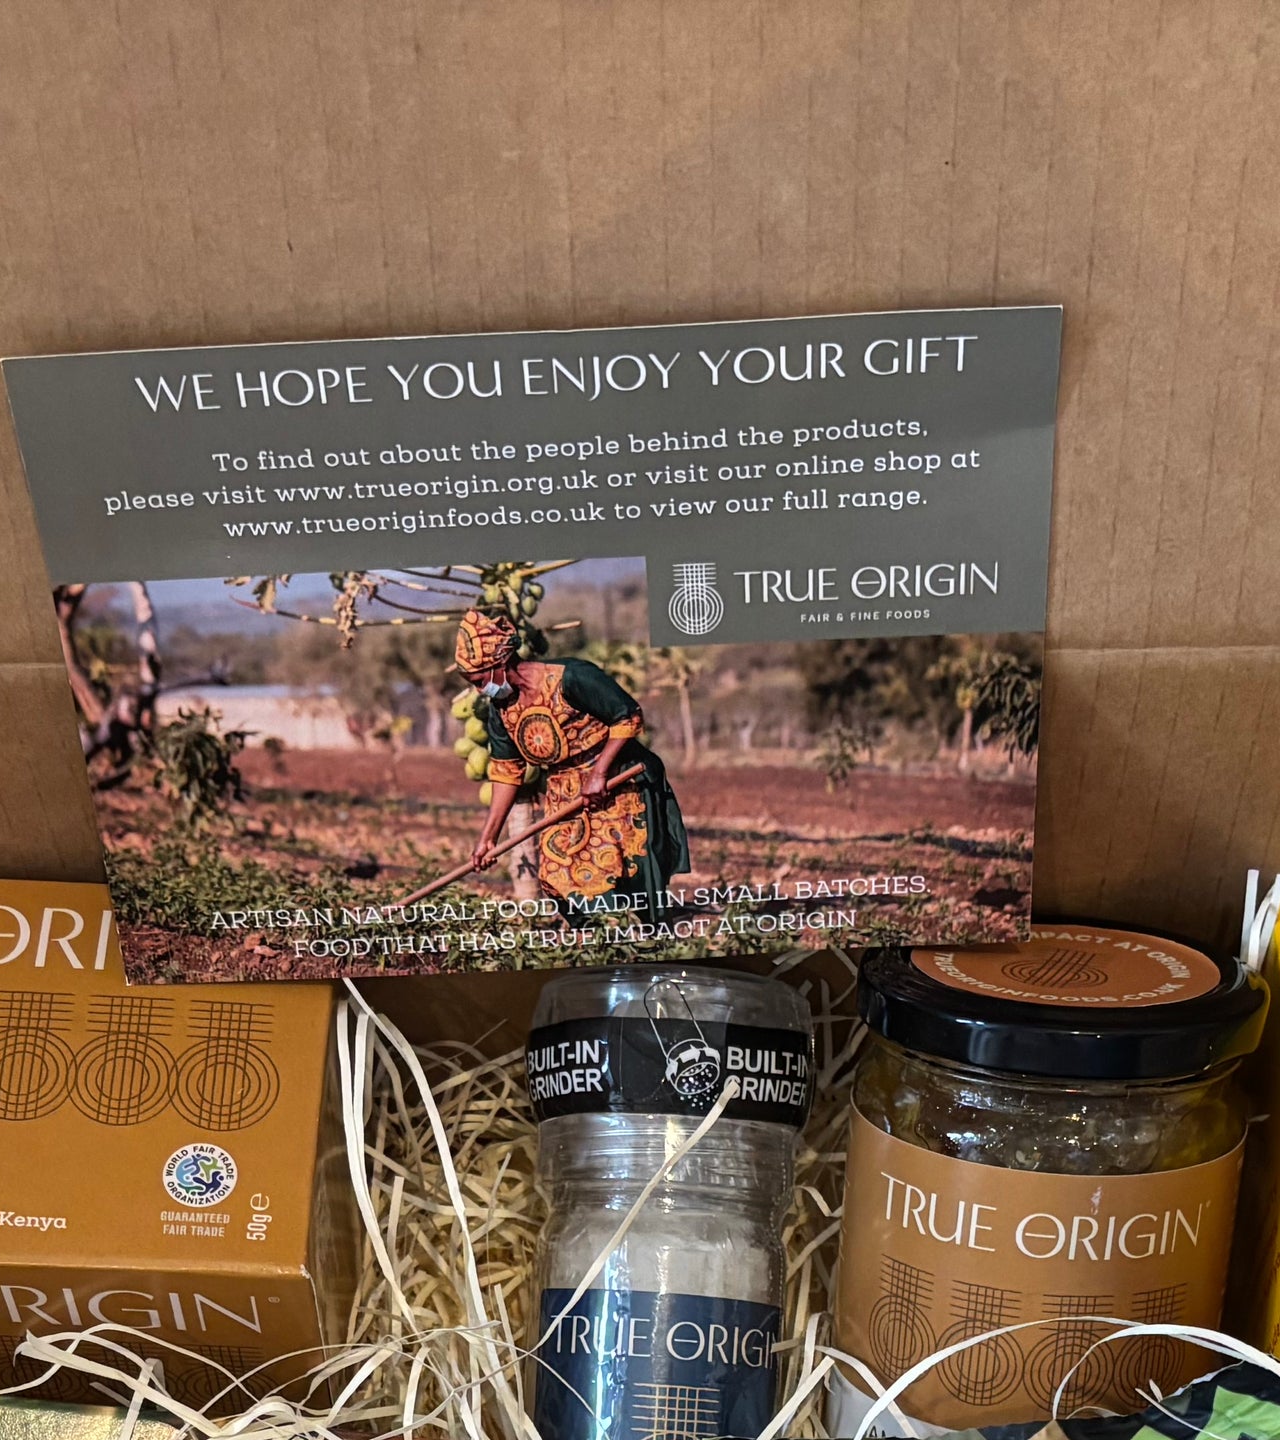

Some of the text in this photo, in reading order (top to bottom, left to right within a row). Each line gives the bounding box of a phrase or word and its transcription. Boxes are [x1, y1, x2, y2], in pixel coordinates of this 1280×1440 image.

[134, 335, 978, 412] WE HOPE YOU ENJOY YOUR GIFT
[212, 418, 929, 472] To find out about the people behind the products,
[104, 449, 980, 515] please visit www.trueorigin.org.uk or visit our online shop at
[223, 489, 927, 538] www.trueoriginfoods.co.uk to view our full range.
[733, 561, 999, 604] TRUE ORIGIN
[800, 608, 931, 623] FAIR FINE FOODS
[210, 876, 931, 930] ARTISAN NATURAL FOOD MADE IN SMALL BATCHES.
[294, 910, 856, 958] FOOD THAT HAS TRUE IMPACT AT ORIGIN
[935, 953, 1186, 1003] TRUEORIGINFOODS.CO.UK
[1114, 942, 1192, 979] AT ORIGIN
[528, 1040, 600, 1073] BUILT-IN
[529, 1068, 602, 1101] GRINDER
[724, 1076, 806, 1107] GRINDER
[166, 1146, 234, 1179] WORLD FAIR TRADE
[167, 1182, 230, 1204] ORGANIZATION
[160, 1211, 230, 1224] GUARANTEED
[163, 1225, 224, 1237] FAIR TRADE
[880, 1171, 1204, 1261] TRUE ORIGIN
[551, 1314, 651, 1359] TRUE
